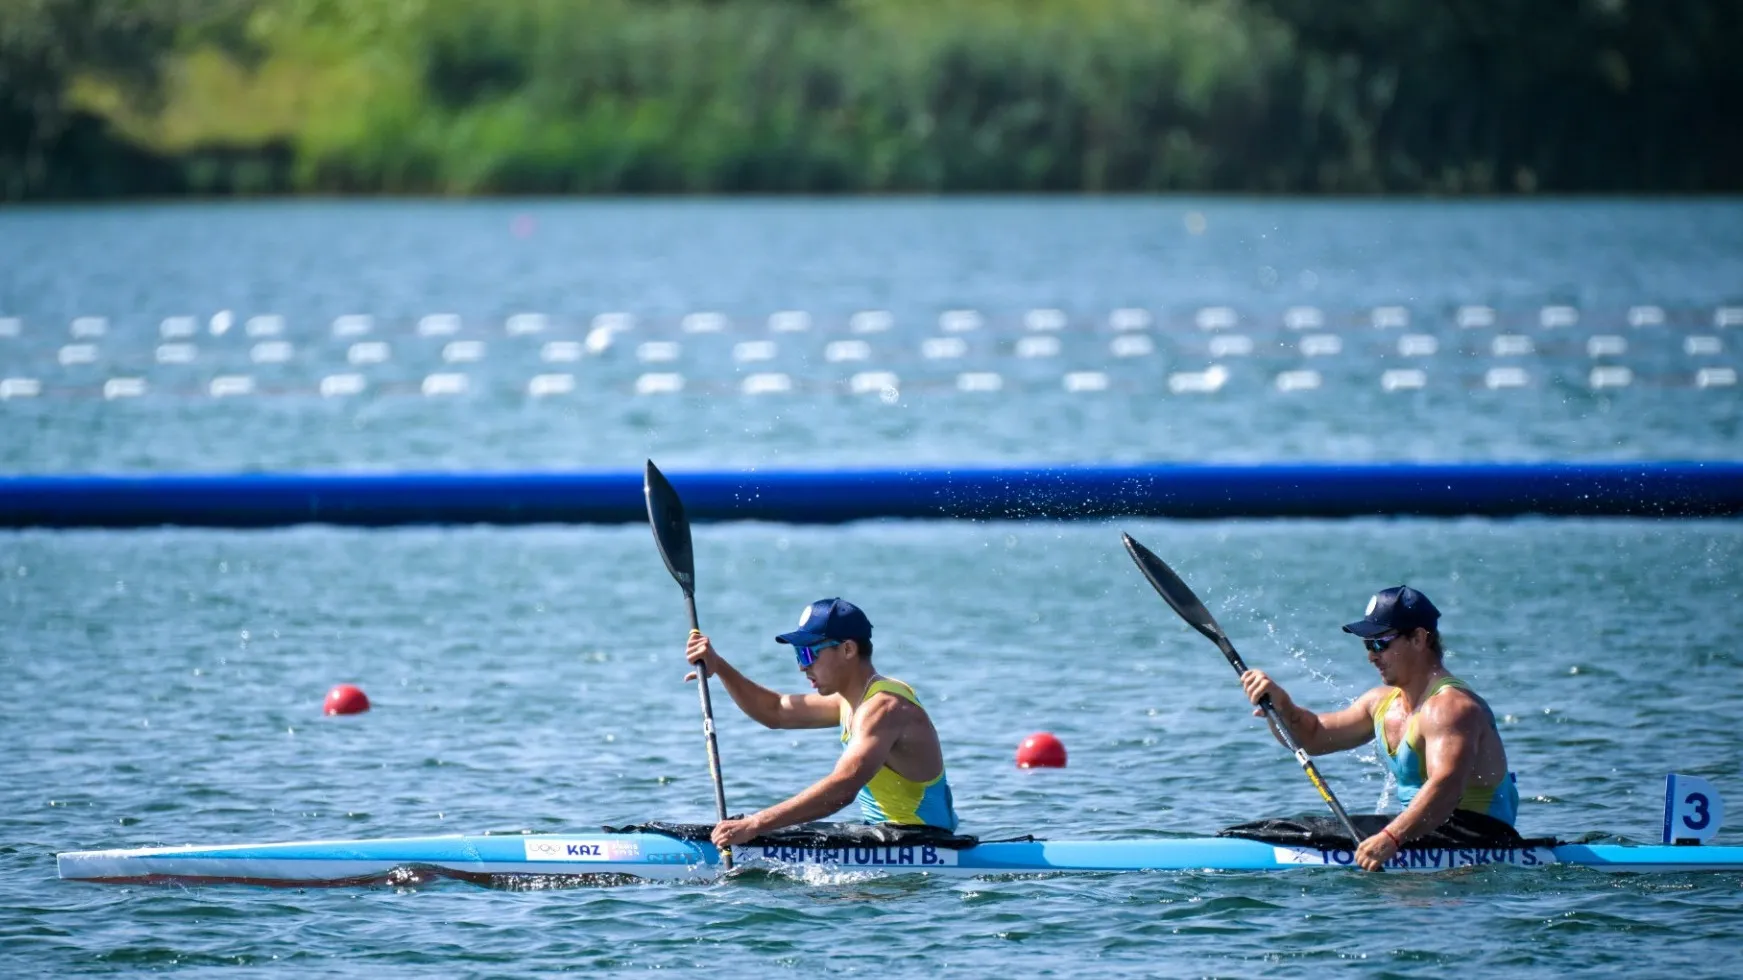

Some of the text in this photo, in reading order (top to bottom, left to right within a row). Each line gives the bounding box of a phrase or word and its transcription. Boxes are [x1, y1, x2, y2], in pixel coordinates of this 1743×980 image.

[1682, 792, 1711, 831] 3
[566, 844, 602, 856] KAZ
[921, 846, 945, 865] B.
[1321, 847, 1544, 868] TORNYTSKYI S.
